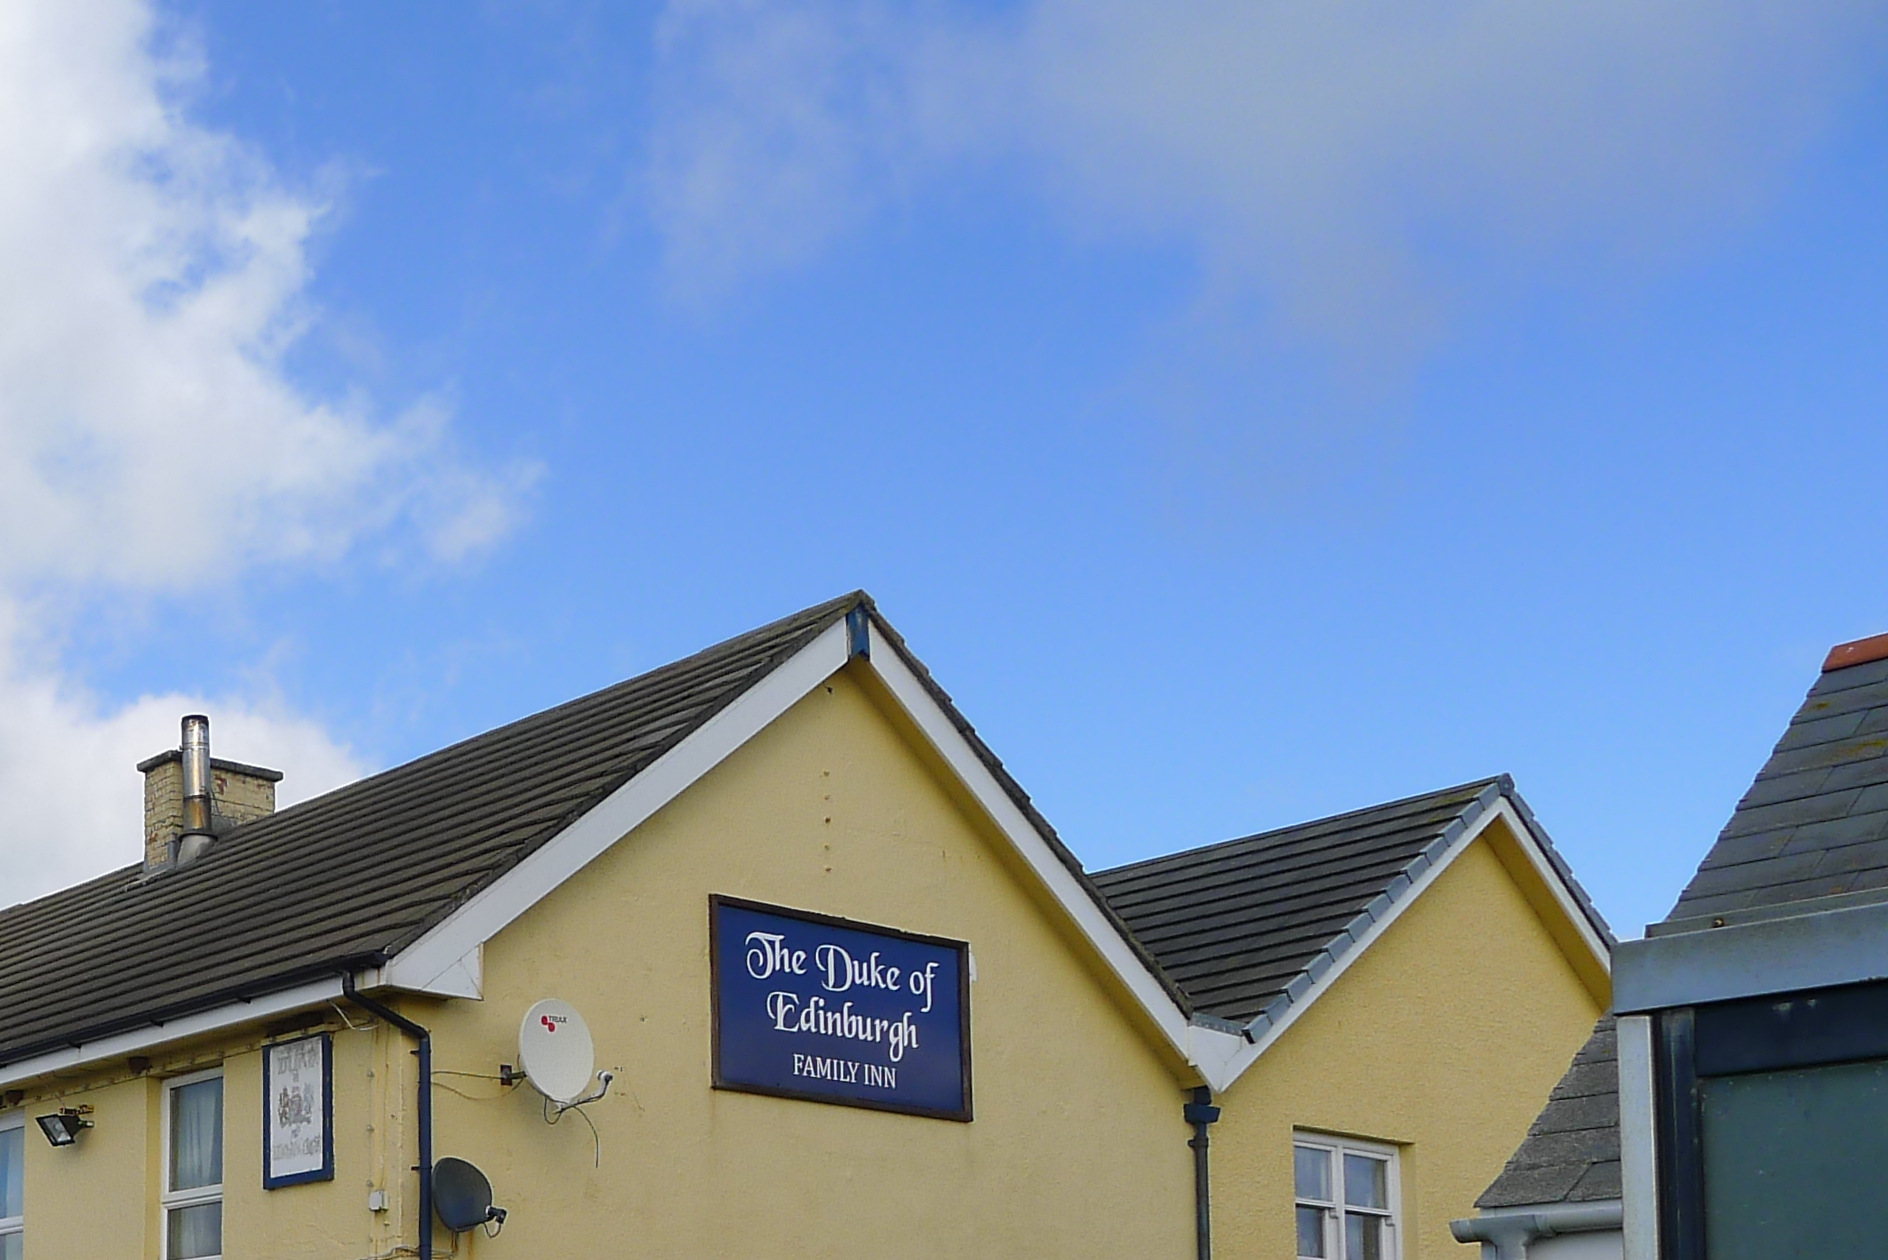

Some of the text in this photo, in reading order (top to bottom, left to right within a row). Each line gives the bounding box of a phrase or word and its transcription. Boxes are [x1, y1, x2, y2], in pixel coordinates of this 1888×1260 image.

[745, 931, 939, 1013] The Duke of
[766, 990, 919, 1063] Edinburgh
[793, 1053, 898, 1089] FAMILY INN
